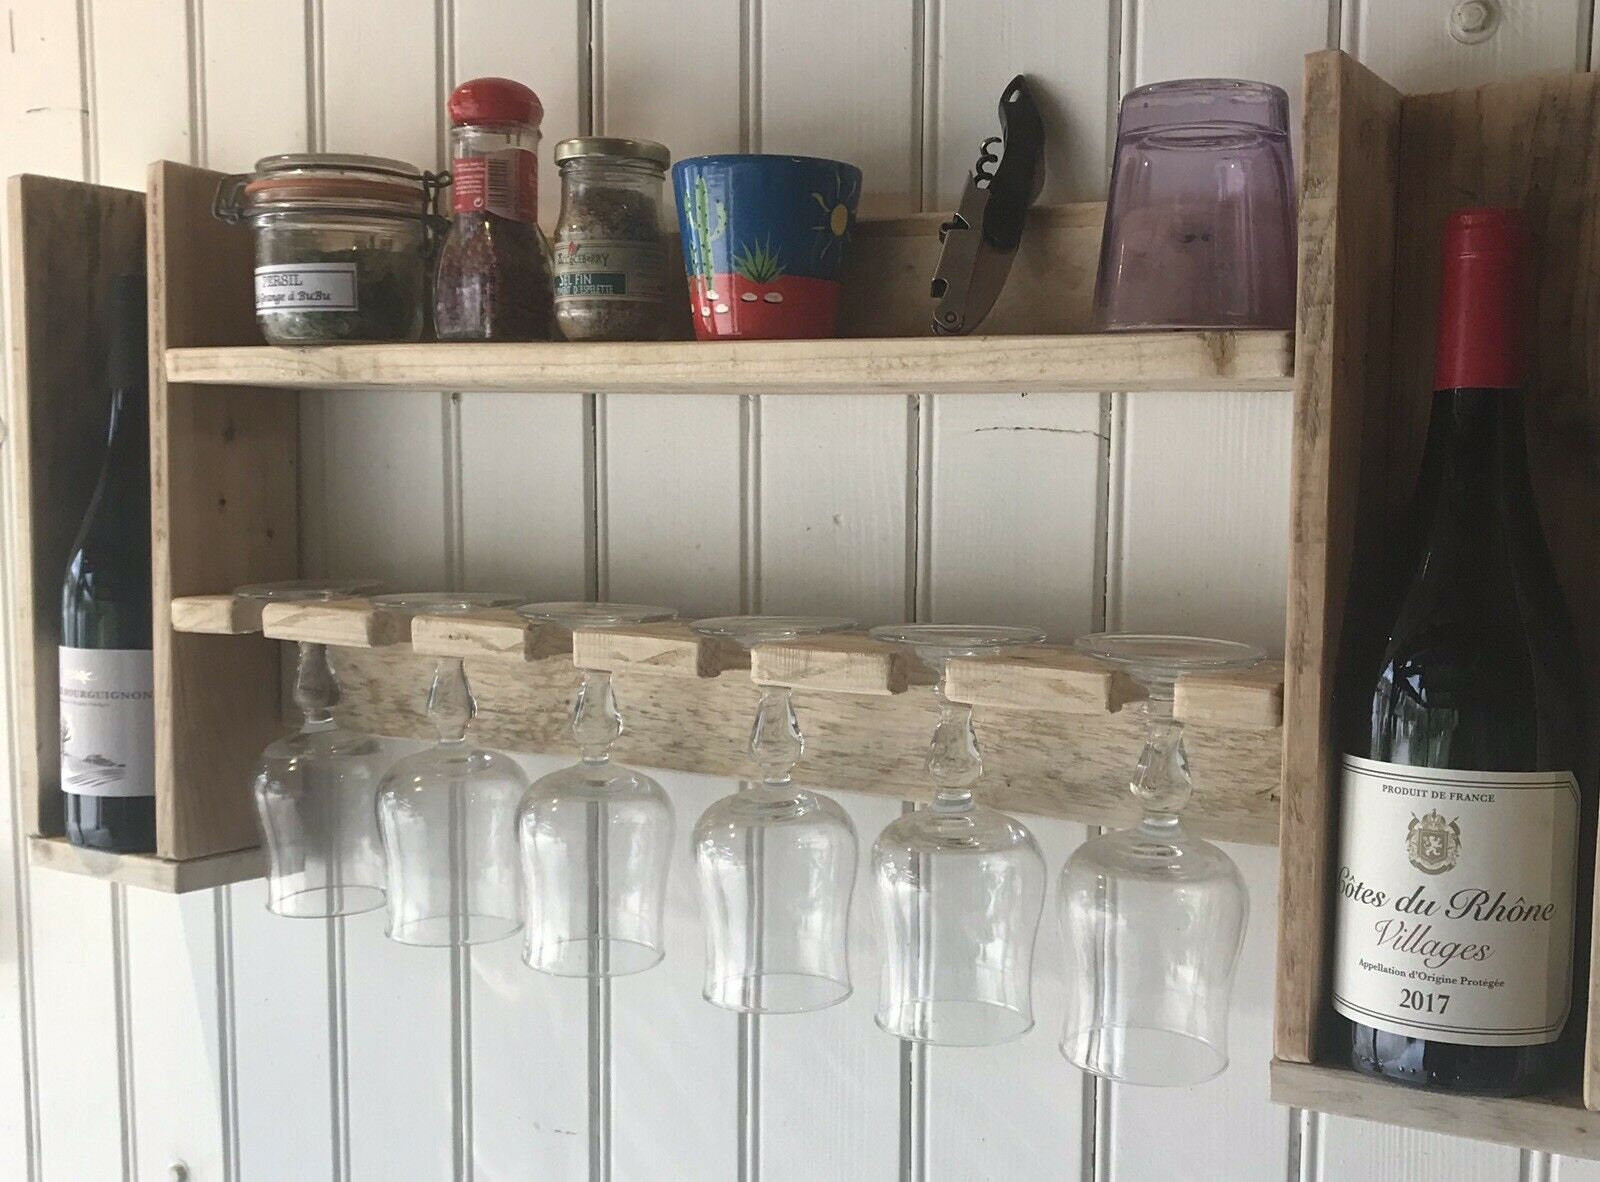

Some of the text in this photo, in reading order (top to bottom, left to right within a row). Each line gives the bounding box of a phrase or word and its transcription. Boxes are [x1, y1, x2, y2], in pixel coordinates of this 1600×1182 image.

[559, 273, 592, 286] SEL FIN
[1381, 784, 1496, 803] PRODUIT DE FRANCE
[1395, 885, 1441, 916] du
[1445, 887, 1556, 923] Rhône
[1374, 919, 1495, 970] Villages
[1359, 958, 1407, 978] Appellation
[1409, 970, 1458, 985] d'Origine
[1398, 988, 1451, 1015] 2017
